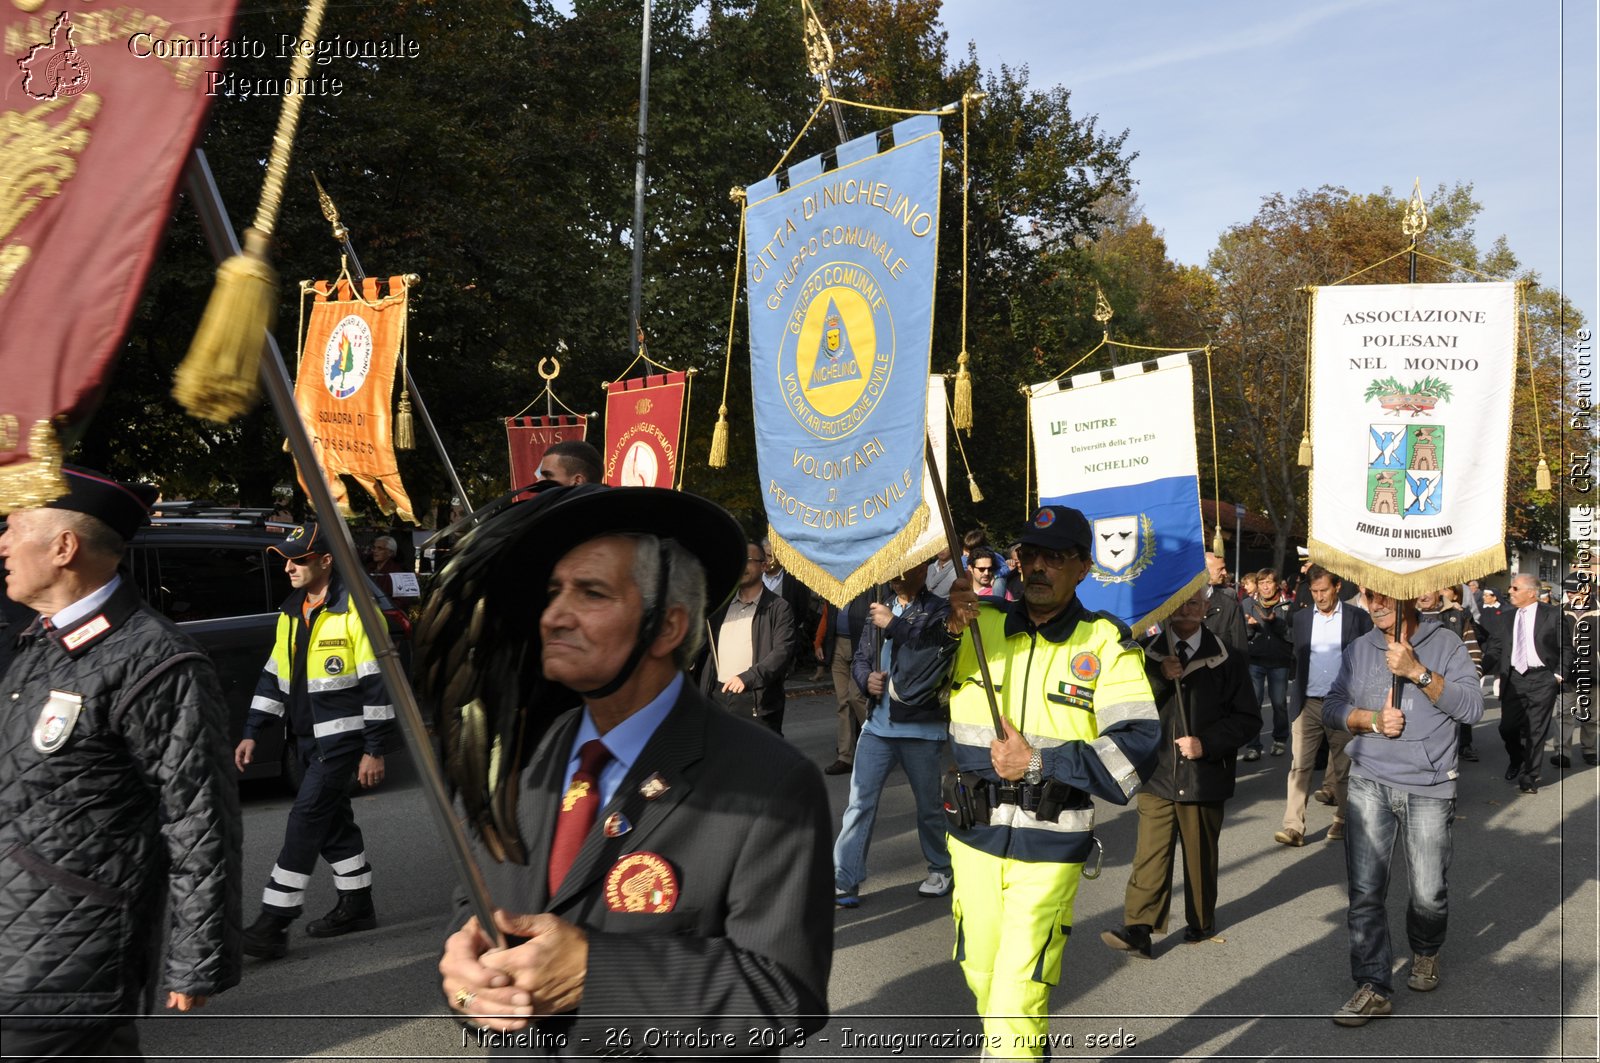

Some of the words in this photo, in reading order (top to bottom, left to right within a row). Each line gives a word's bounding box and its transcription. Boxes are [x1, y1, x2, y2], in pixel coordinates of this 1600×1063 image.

[801, 192, 819, 221] DI
[823, 179, 932, 238] NICHELINO
[767, 237, 818, 310] GRUPPO
[821, 225, 909, 280] COMUNALE
[790, 275, 823, 334] GRUPPO
[824, 266, 885, 314] COMUNALE
[1342, 310, 1486, 325] ASSOCIAZIONE
[1362, 335, 1459, 348] POLESANI
[813, 360, 857, 383] NICHELINO
[1349, 357, 1387, 370] NEL
[1404, 358, 1479, 371] MONDO
[784, 372, 820, 430] VOLONTARI
[821, 394, 873, 435] PROTEZIONE
[868, 353, 890, 397] CIVILE
[319, 410, 352, 425] SQUADRA
[357, 413, 366, 426] DI
[1074, 418, 1117, 432] UNITRE
[630, 422, 655, 437] SANGUE
[1071, 442, 1107, 453] Università
[1109, 439, 1127, 447] delle
[1143, 433, 1156, 442] Età
[792, 437, 885, 481] VOLONTARI
[1084, 456, 1149, 474] NICHELINO
[769, 479, 858, 529] PROTEZIONE
[863, 469, 913, 519] CIVILE
[1356, 522, 1390, 537] FAMEJA
[1392, 528, 1402, 539] DI
[1404, 525, 1453, 539] NICHELINO
[1385, 547, 1421, 559] TORINO
